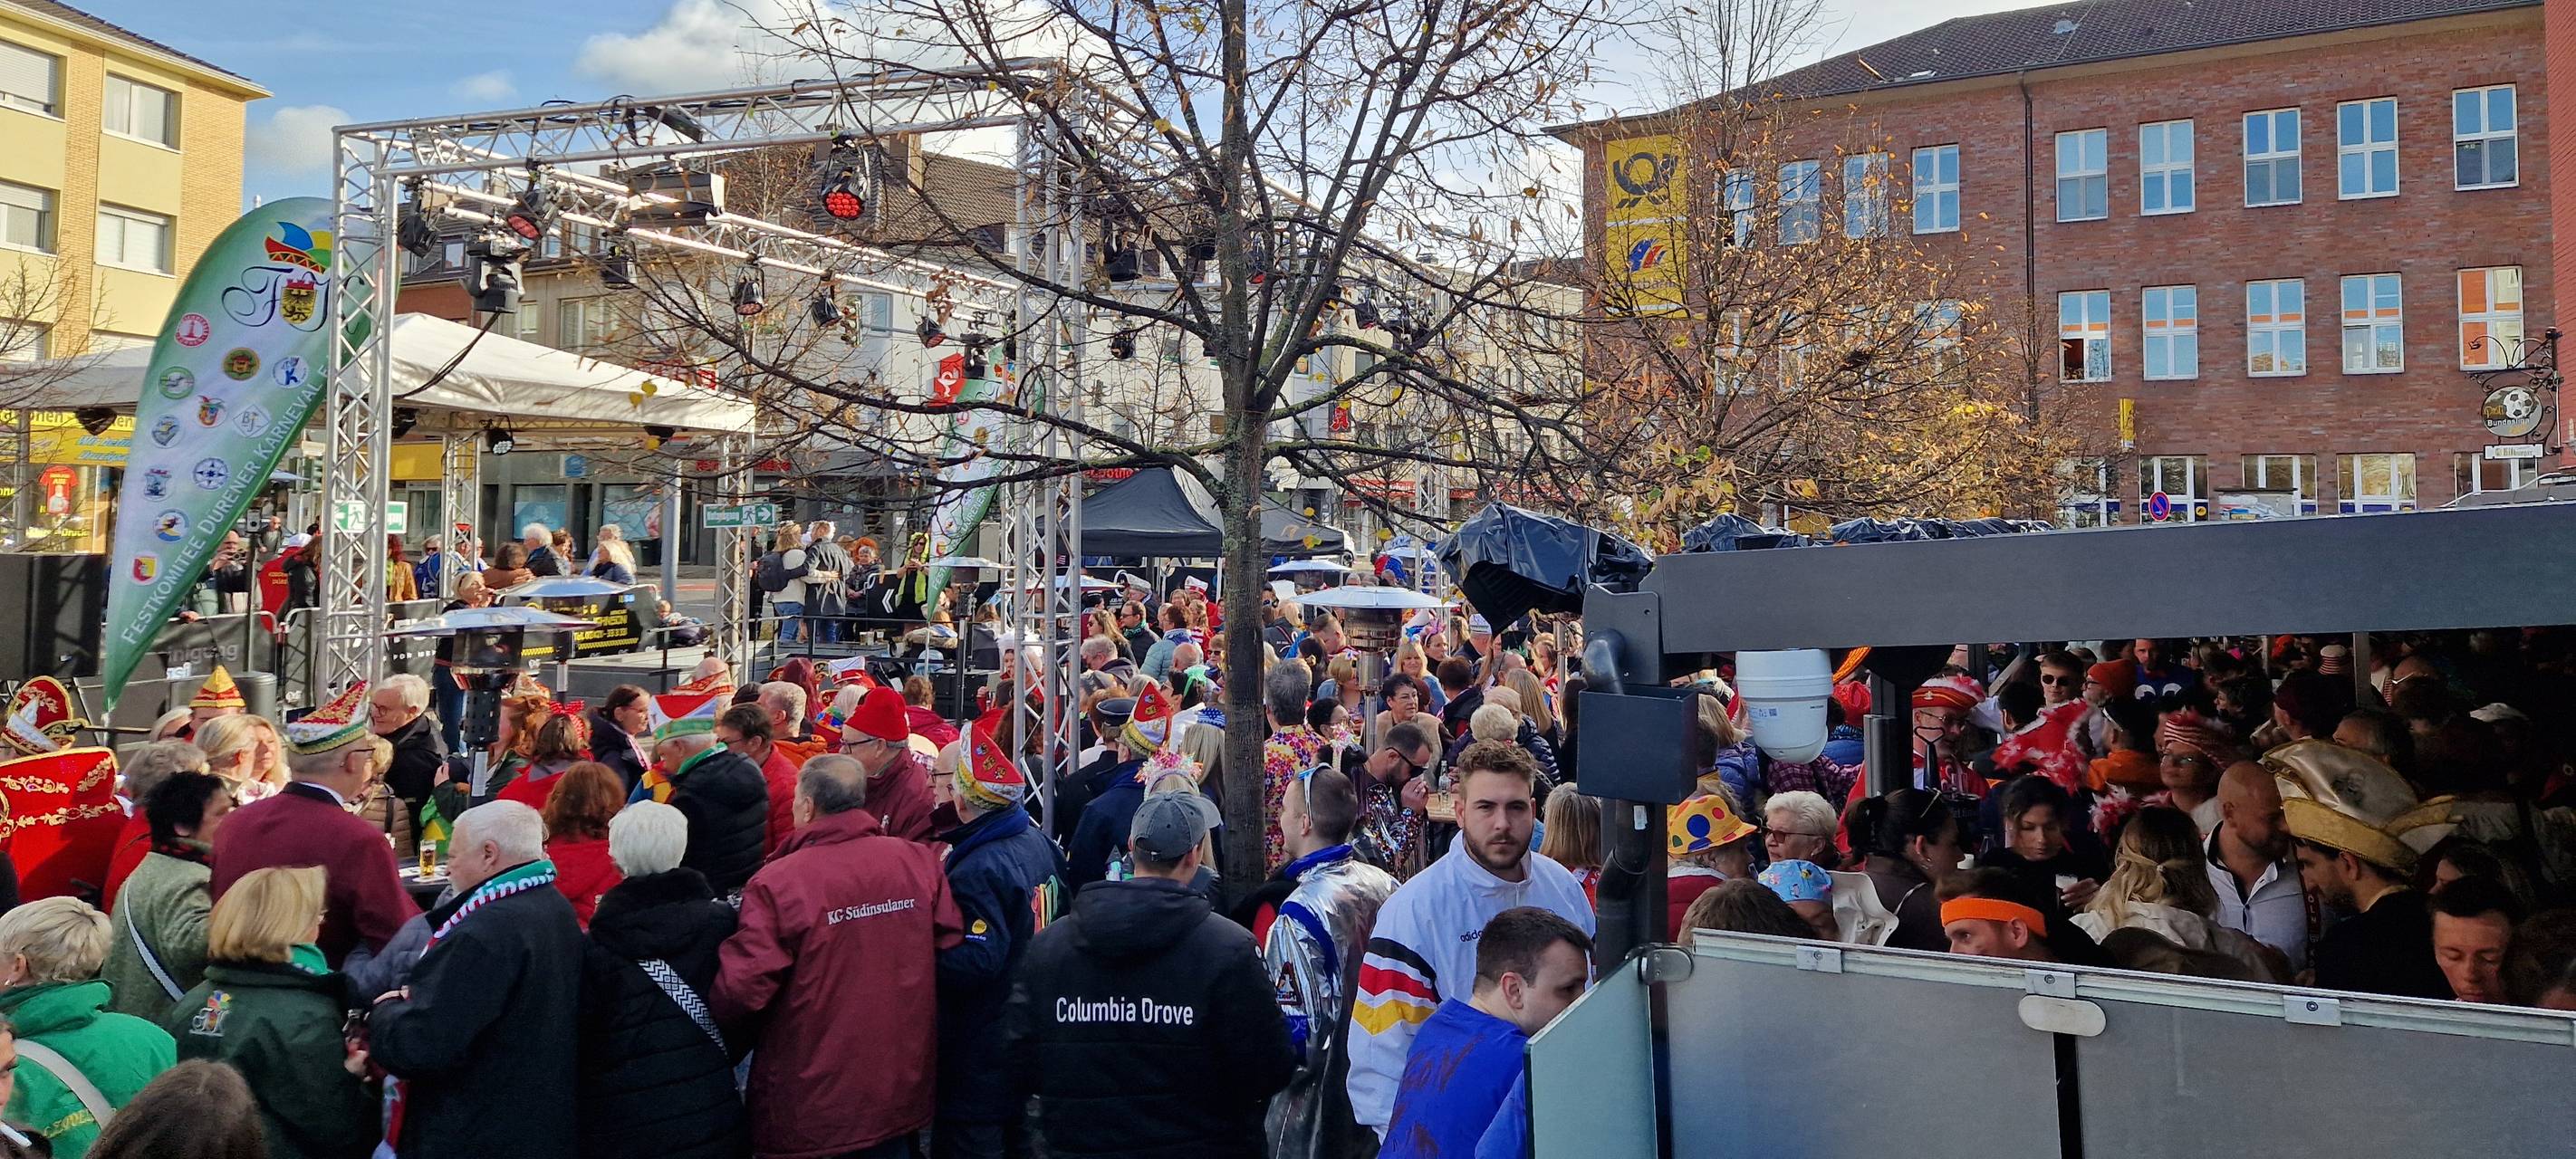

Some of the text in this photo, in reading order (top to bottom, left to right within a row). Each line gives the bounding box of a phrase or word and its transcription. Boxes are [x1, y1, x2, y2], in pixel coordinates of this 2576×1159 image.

[121, 535, 207, 645] FESTKOMITEE
[254, 382, 322, 463] KARNEVAL
[826, 898, 916, 924] KG Südinsulaner
[1056, 996, 1195, 1026] Columbia Drove
